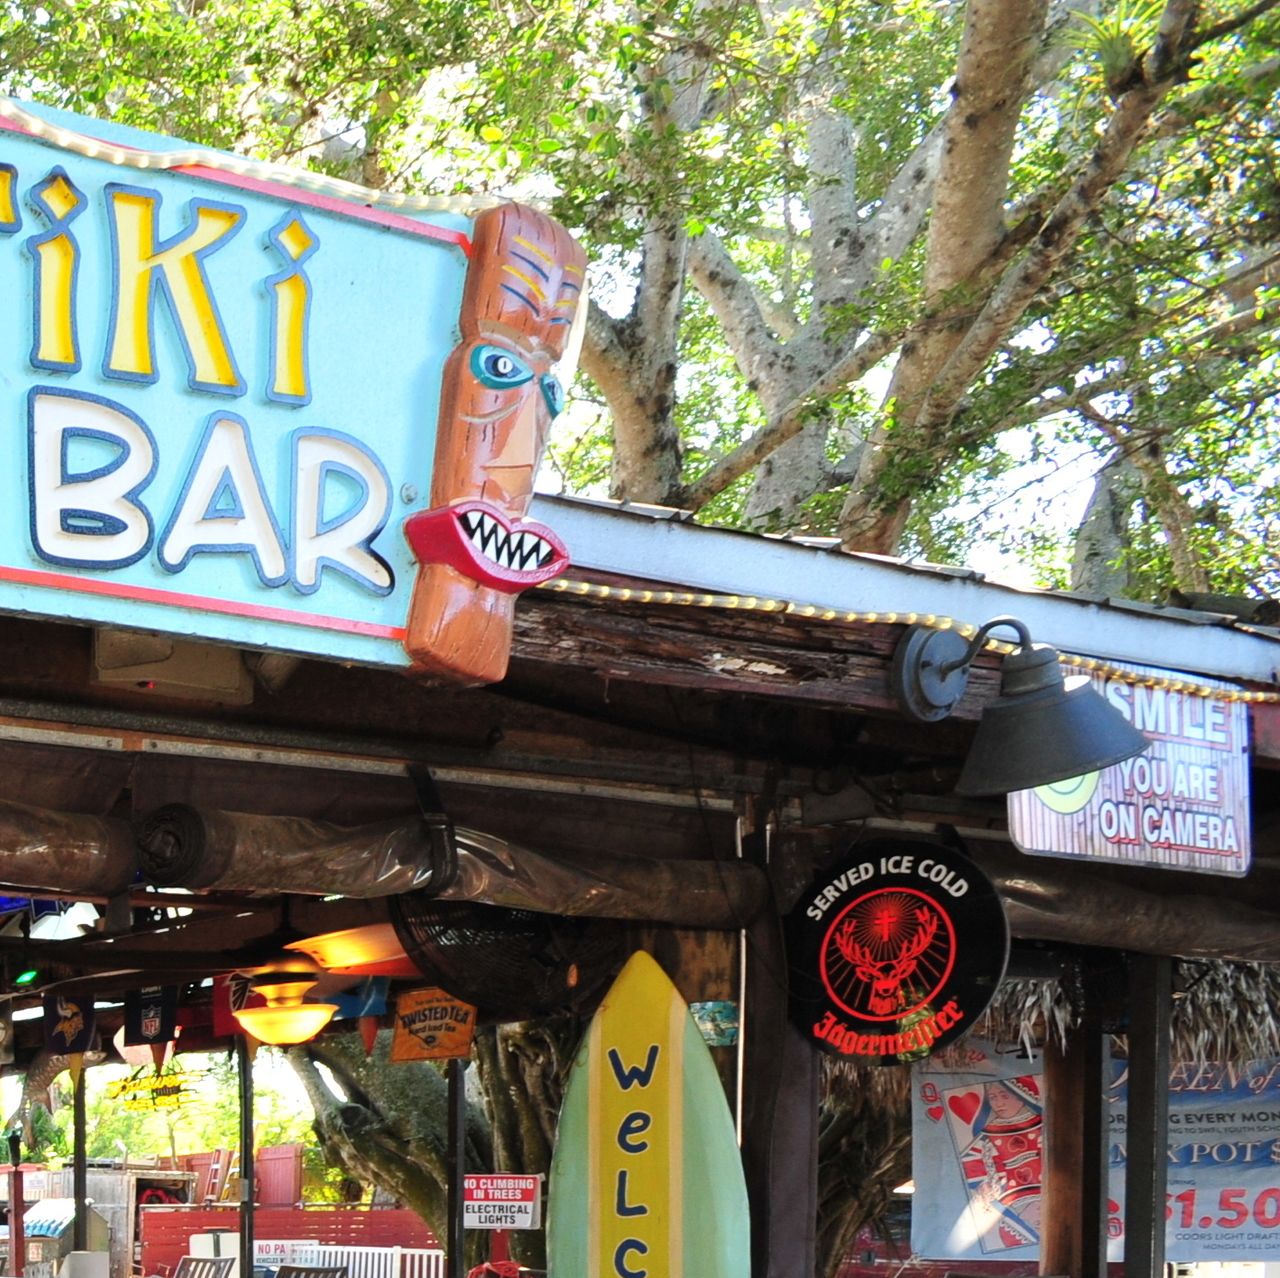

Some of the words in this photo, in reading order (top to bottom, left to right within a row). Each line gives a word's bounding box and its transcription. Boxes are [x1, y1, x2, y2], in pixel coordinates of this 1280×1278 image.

[28, 385, 396, 595] BAR
[1106, 680, 1228, 745] SMILE
[1121, 758, 1167, 796] YOU
[1174, 769, 1218, 802] ARE
[1100, 801, 1137, 842] ON
[1142, 807, 1239, 852] CAMERA
[807, 861, 876, 922] SERVED
[879, 855, 913, 876] ICE
[917, 859, 970, 900] COLD
[1185, 1113, 1236, 1124] EVERY
[1191, 1142, 1261, 1163] POT
[480, 1179, 533, 1189] CLIMBING
[473, 1189, 484, 1199] IN
[488, 1189, 521, 1199] TREES
[466, 1205, 529, 1214] ELECTRICAL
[479, 1215, 516, 1224] LIGHTS
[258, 1244, 270, 1254] NO
